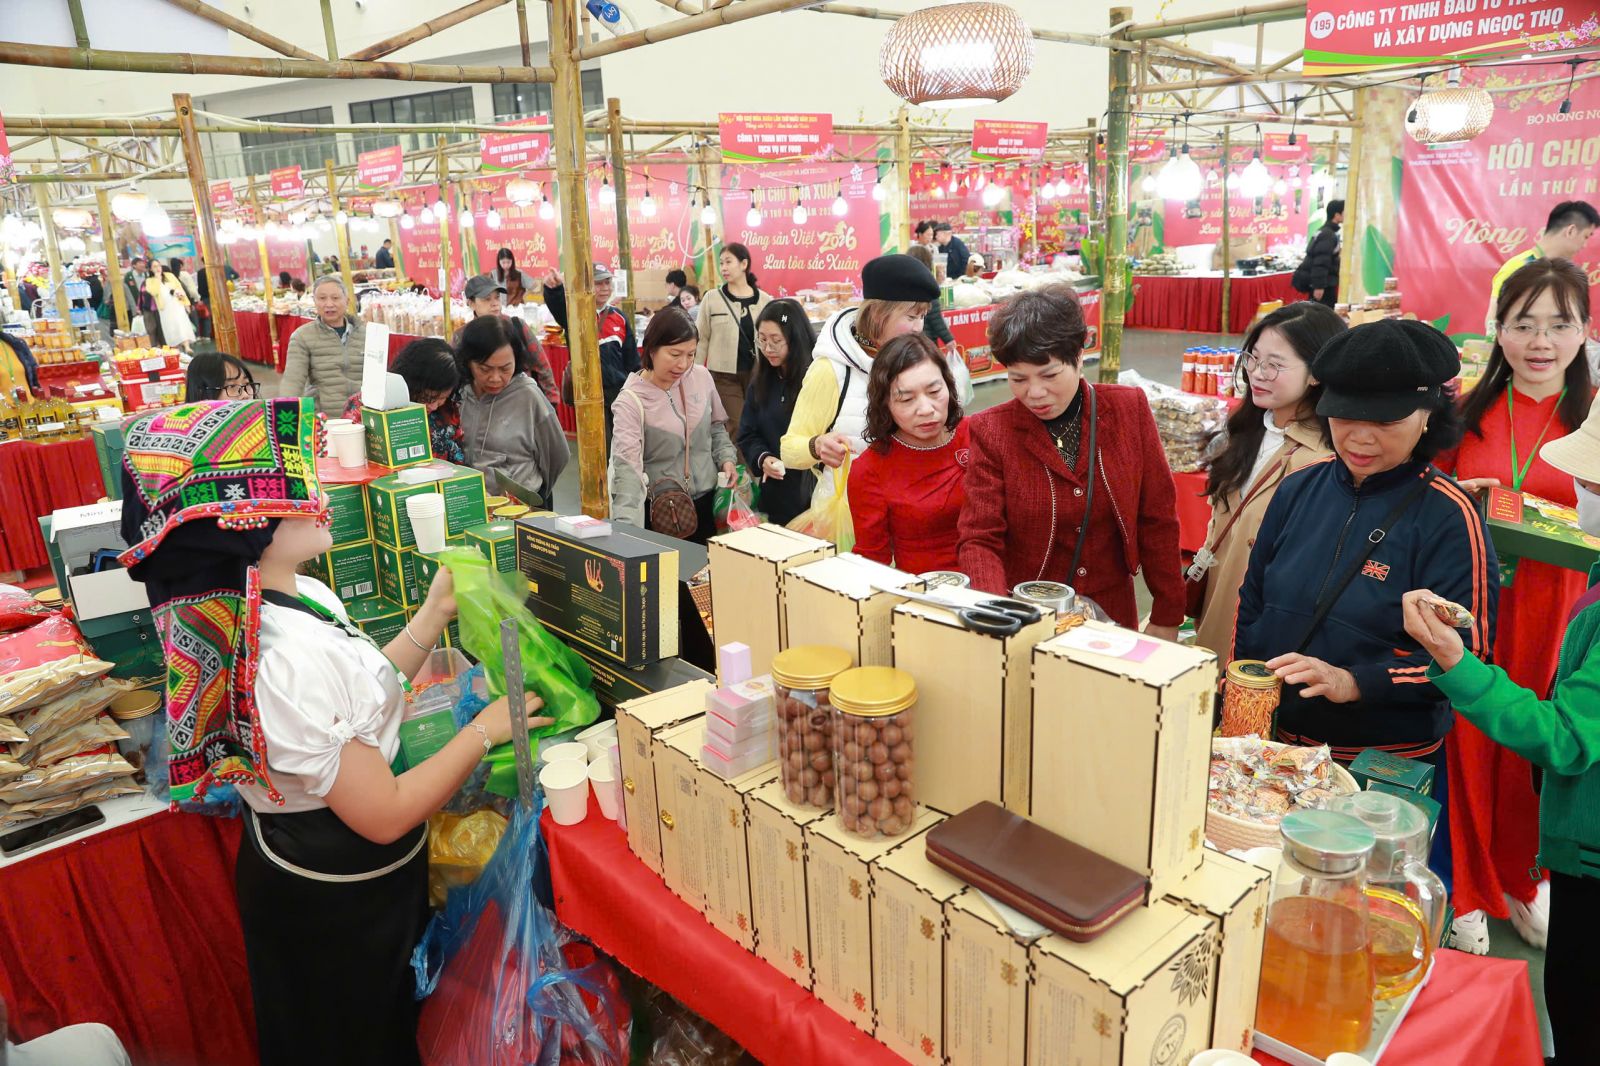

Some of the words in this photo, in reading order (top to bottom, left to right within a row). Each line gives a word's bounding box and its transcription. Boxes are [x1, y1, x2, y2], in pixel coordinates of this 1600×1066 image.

[1314, 17, 1331, 31] 195
[1336, 8, 1375, 31] CÔNG
[1379, 8, 1396, 26] TY
[1400, 1, 1441, 21] TNHH
[1373, 26, 1392, 48] VÀ
[1395, 24, 1424, 46] XÂY
[1429, 19, 1474, 43] DỰNG
[1477, 14, 1524, 36] NGỌC
[1530, 8, 1565, 28] THỌ
[1488, 137, 1535, 175] HỘI
[1542, 177, 1578, 194] THỨ
[741, 230, 770, 252] Nông
[772, 232, 790, 246] sản
[791, 228, 817, 249] Việt
[1445, 218, 1528, 254] Nông
[763, 253, 786, 270] Lan
[807, 252, 825, 270] sắc
[826, 253, 860, 271] Xuân
